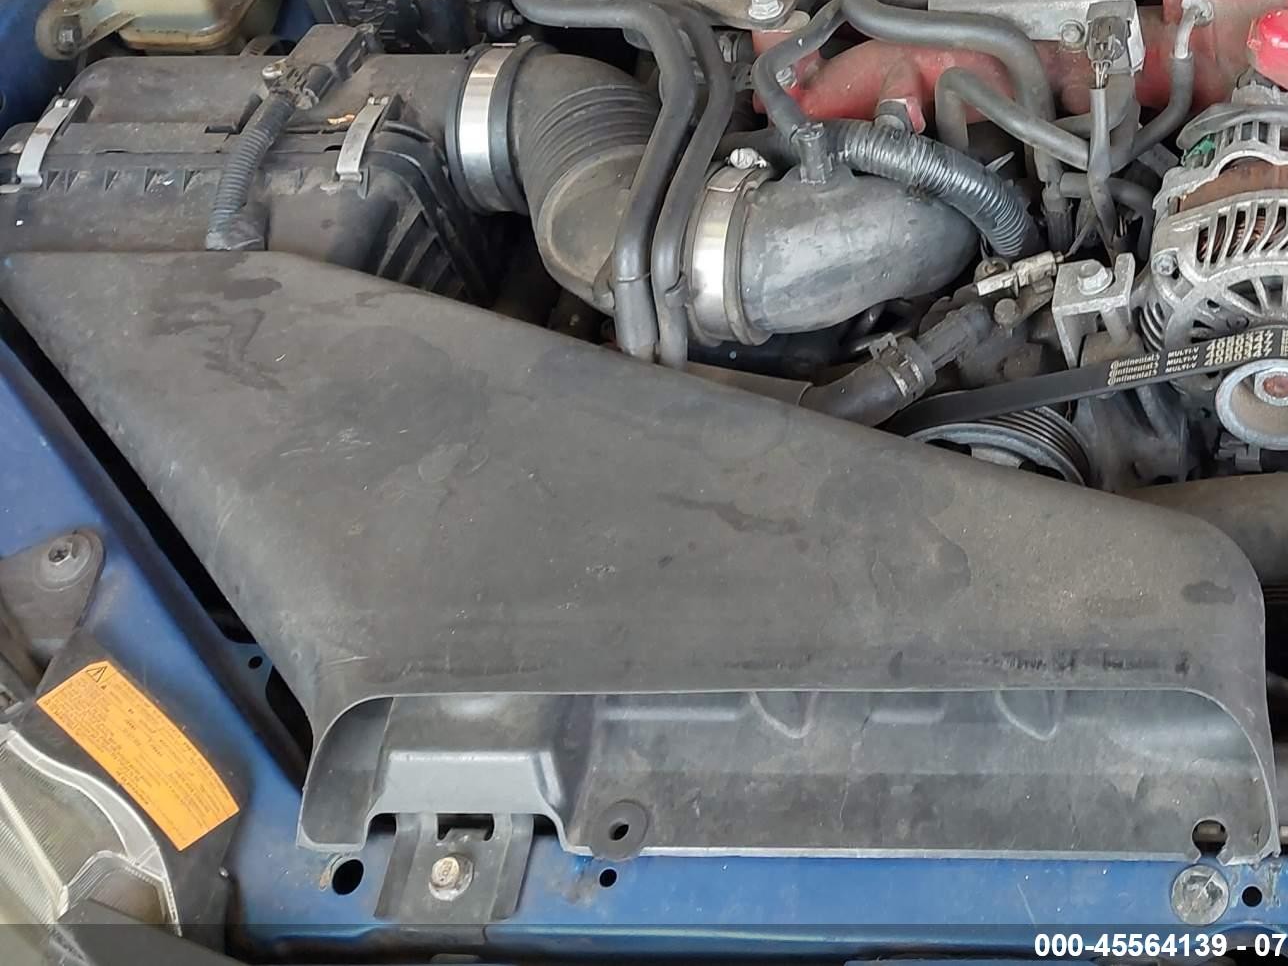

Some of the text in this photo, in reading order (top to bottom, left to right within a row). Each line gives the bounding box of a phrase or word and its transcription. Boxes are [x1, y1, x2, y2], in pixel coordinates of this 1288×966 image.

[1168, 346, 1200, 357] MULTI-V
[1166, 355, 1198, 366] MULTI-V
[1165, 363, 1197, 373] MULTI-V
